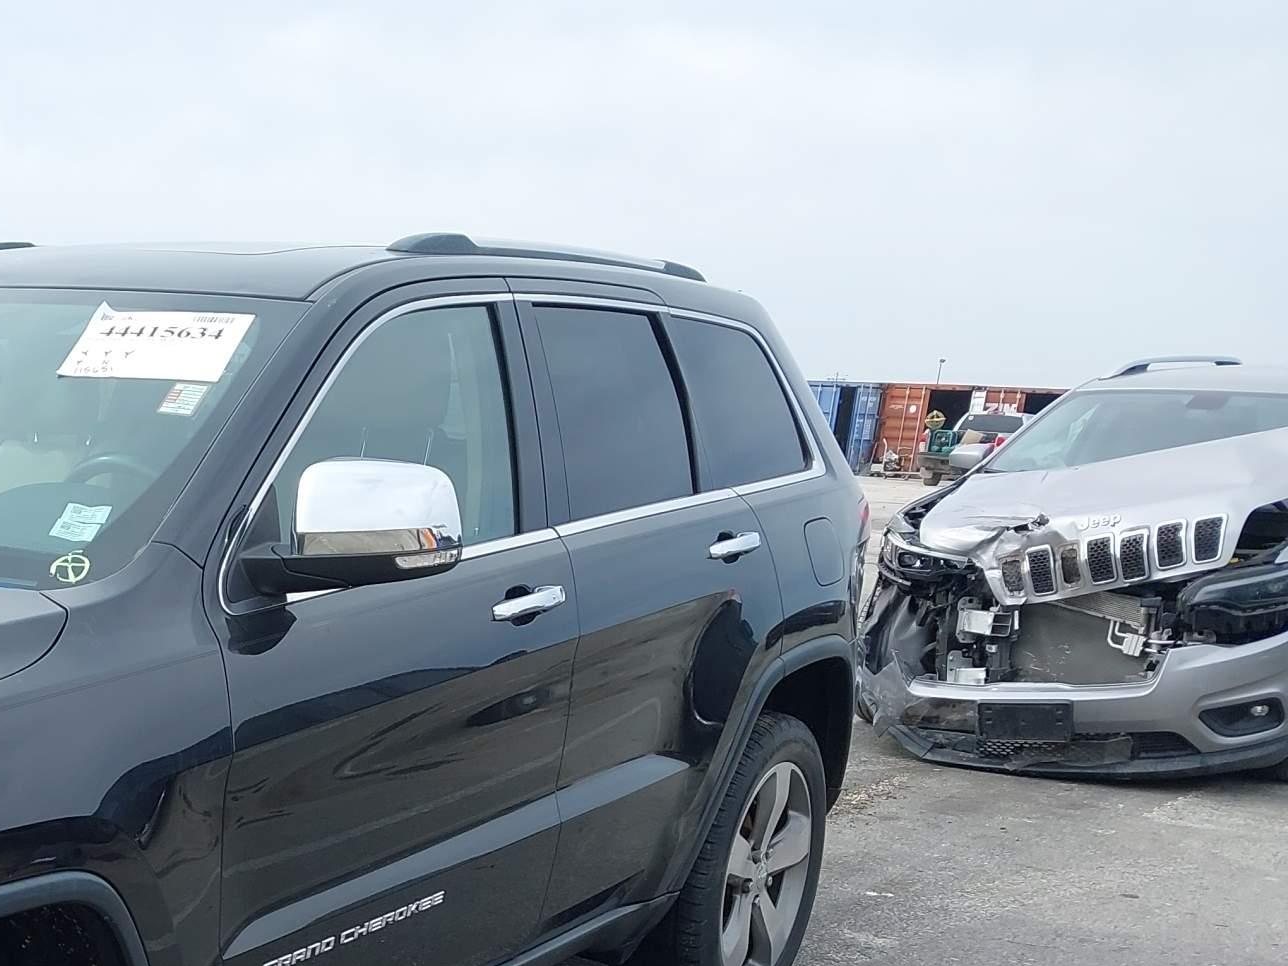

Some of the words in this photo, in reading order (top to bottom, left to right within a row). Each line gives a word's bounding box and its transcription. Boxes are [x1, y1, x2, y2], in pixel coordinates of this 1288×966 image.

[100, 325, 225, 340] 44415634
[1077, 513, 1122, 531] Jeep
[340, 890, 446, 945] CHEROKEE
